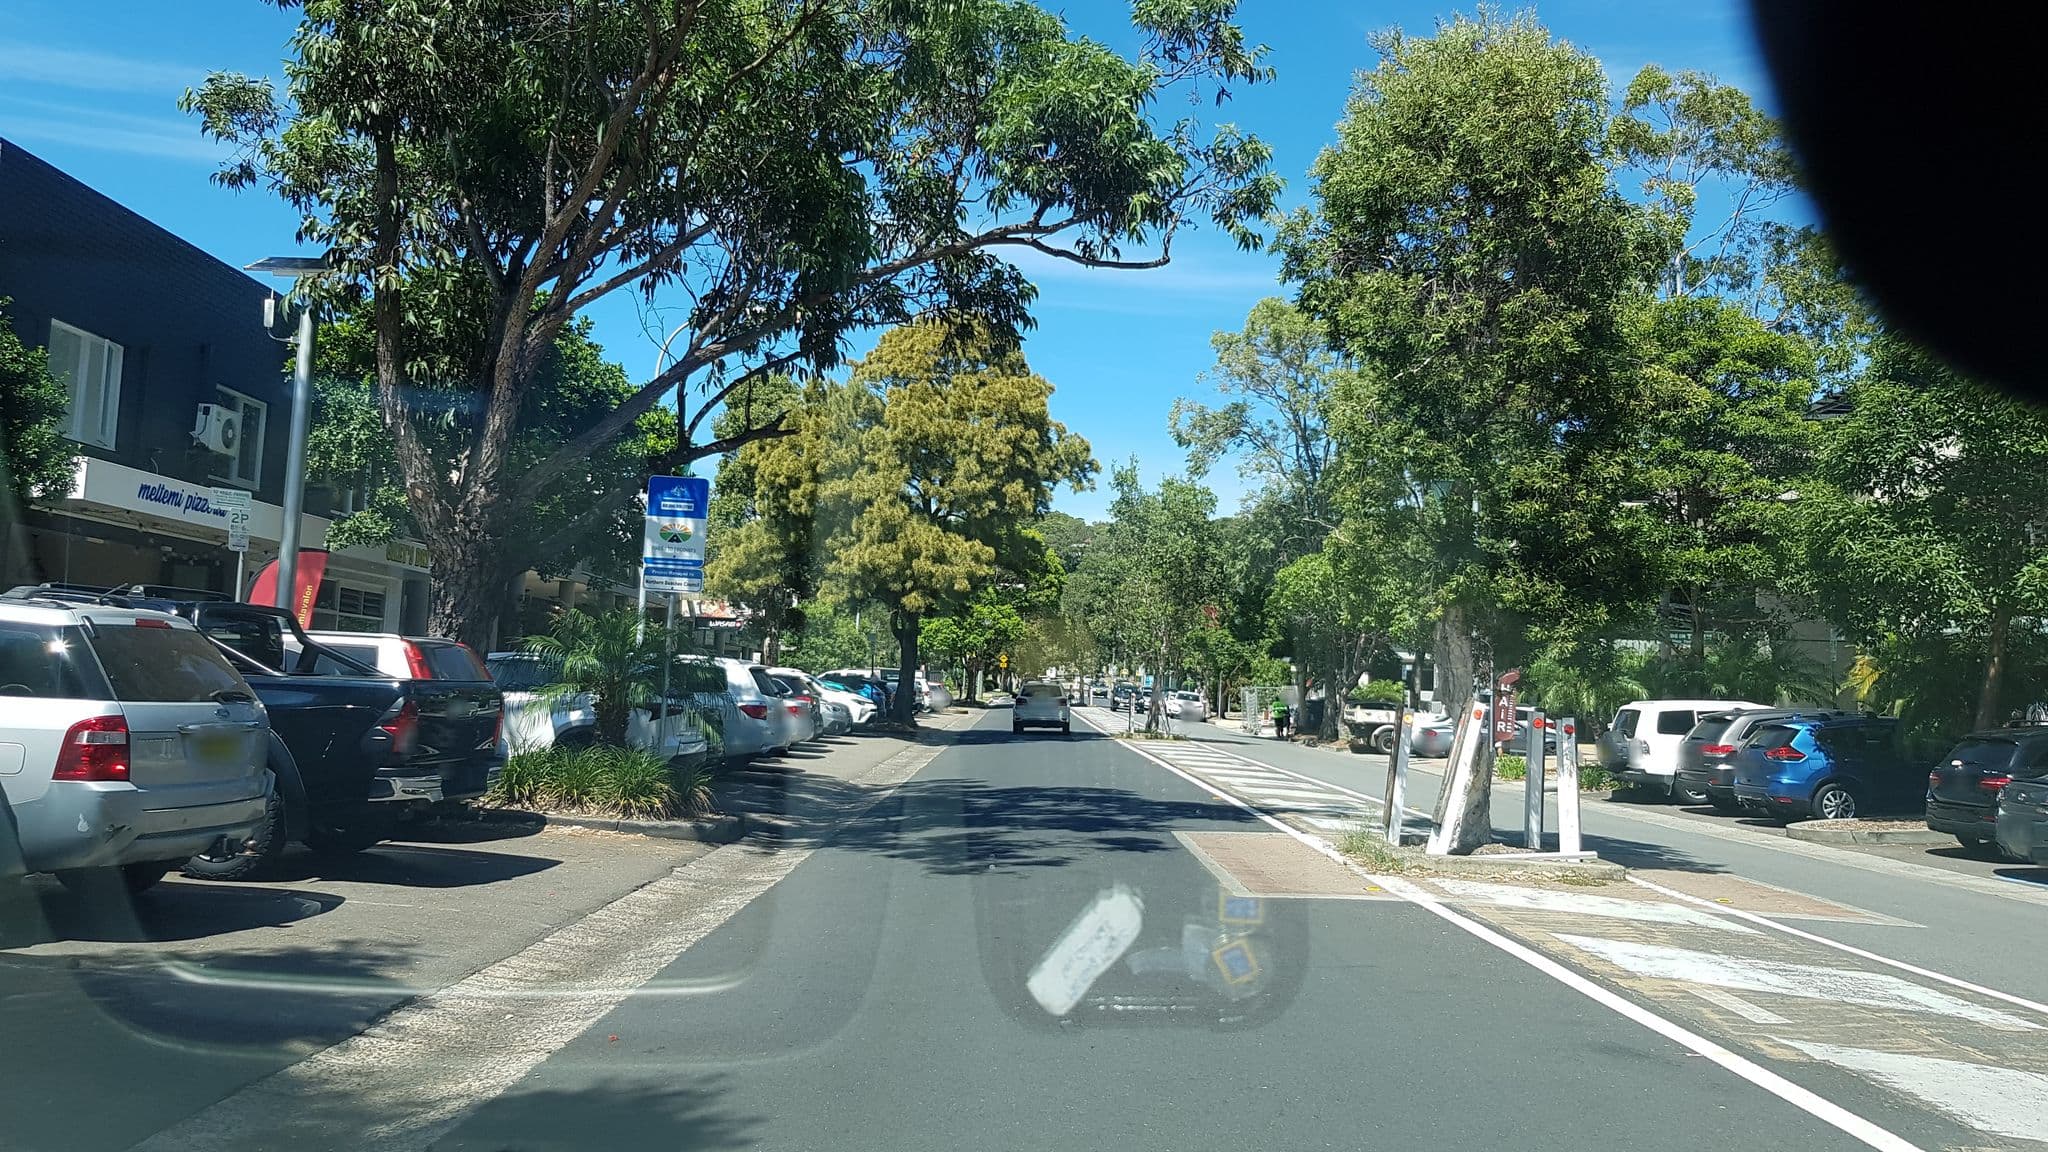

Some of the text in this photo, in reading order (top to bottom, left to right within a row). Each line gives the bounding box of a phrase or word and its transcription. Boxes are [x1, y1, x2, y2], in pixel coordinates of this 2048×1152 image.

[138, 483, 184, 507] meltemi
[183, 492, 228, 515] pizz
[231, 513, 249, 524] 2P
